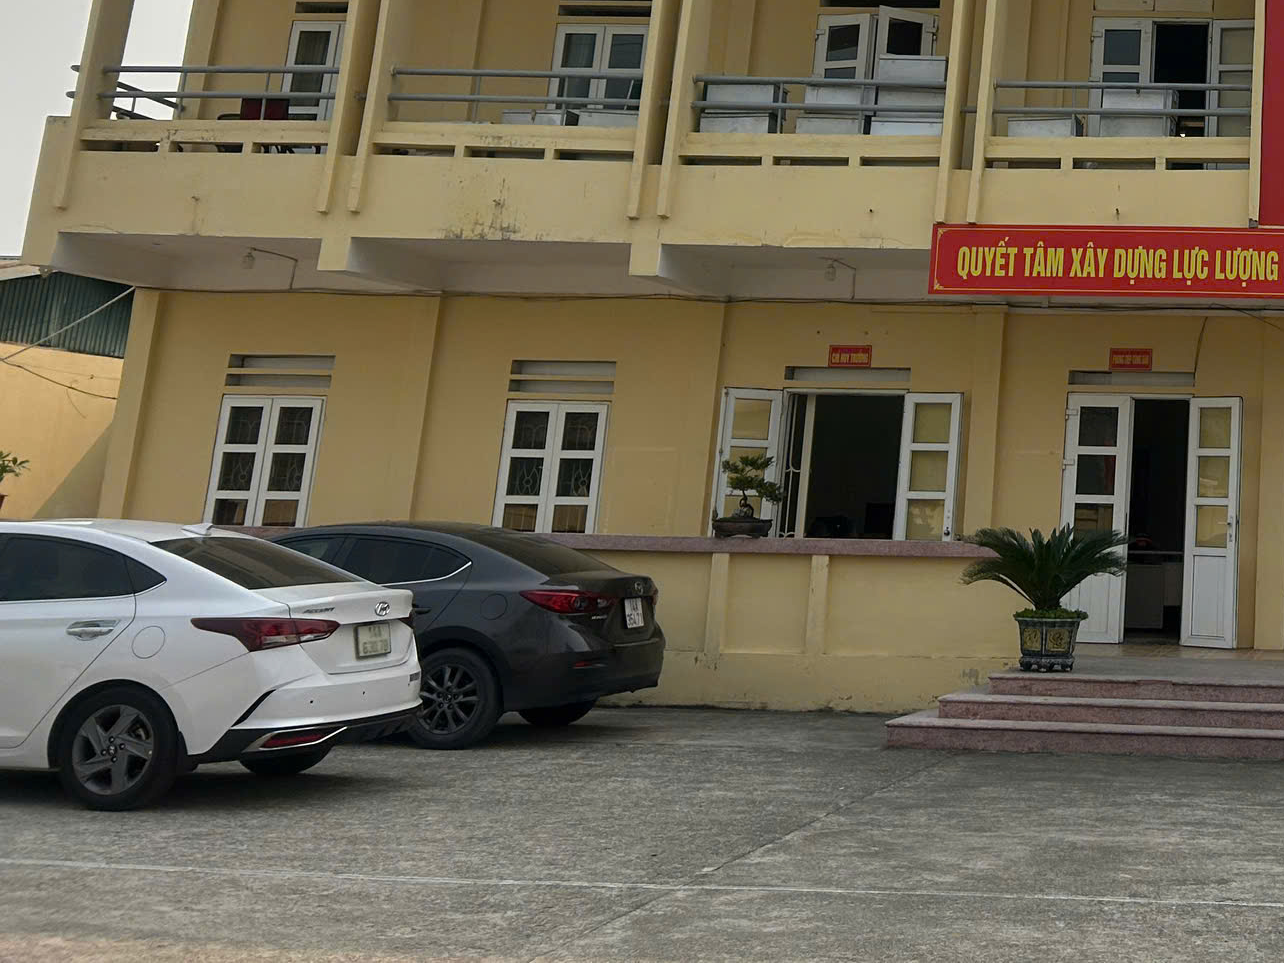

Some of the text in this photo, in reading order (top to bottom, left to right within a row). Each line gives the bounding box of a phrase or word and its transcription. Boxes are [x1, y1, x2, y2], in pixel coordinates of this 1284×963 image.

[957, 237, 1018, 280] QUYẾT
[1023, 241, 1065, 278] TÂM
[1070, 242, 1109, 278] XÂY
[1113, 246, 1167, 285] DỰNG
[1172, 246, 1209, 286] LỰC
[1214, 247, 1279, 287] LƯỢNG
